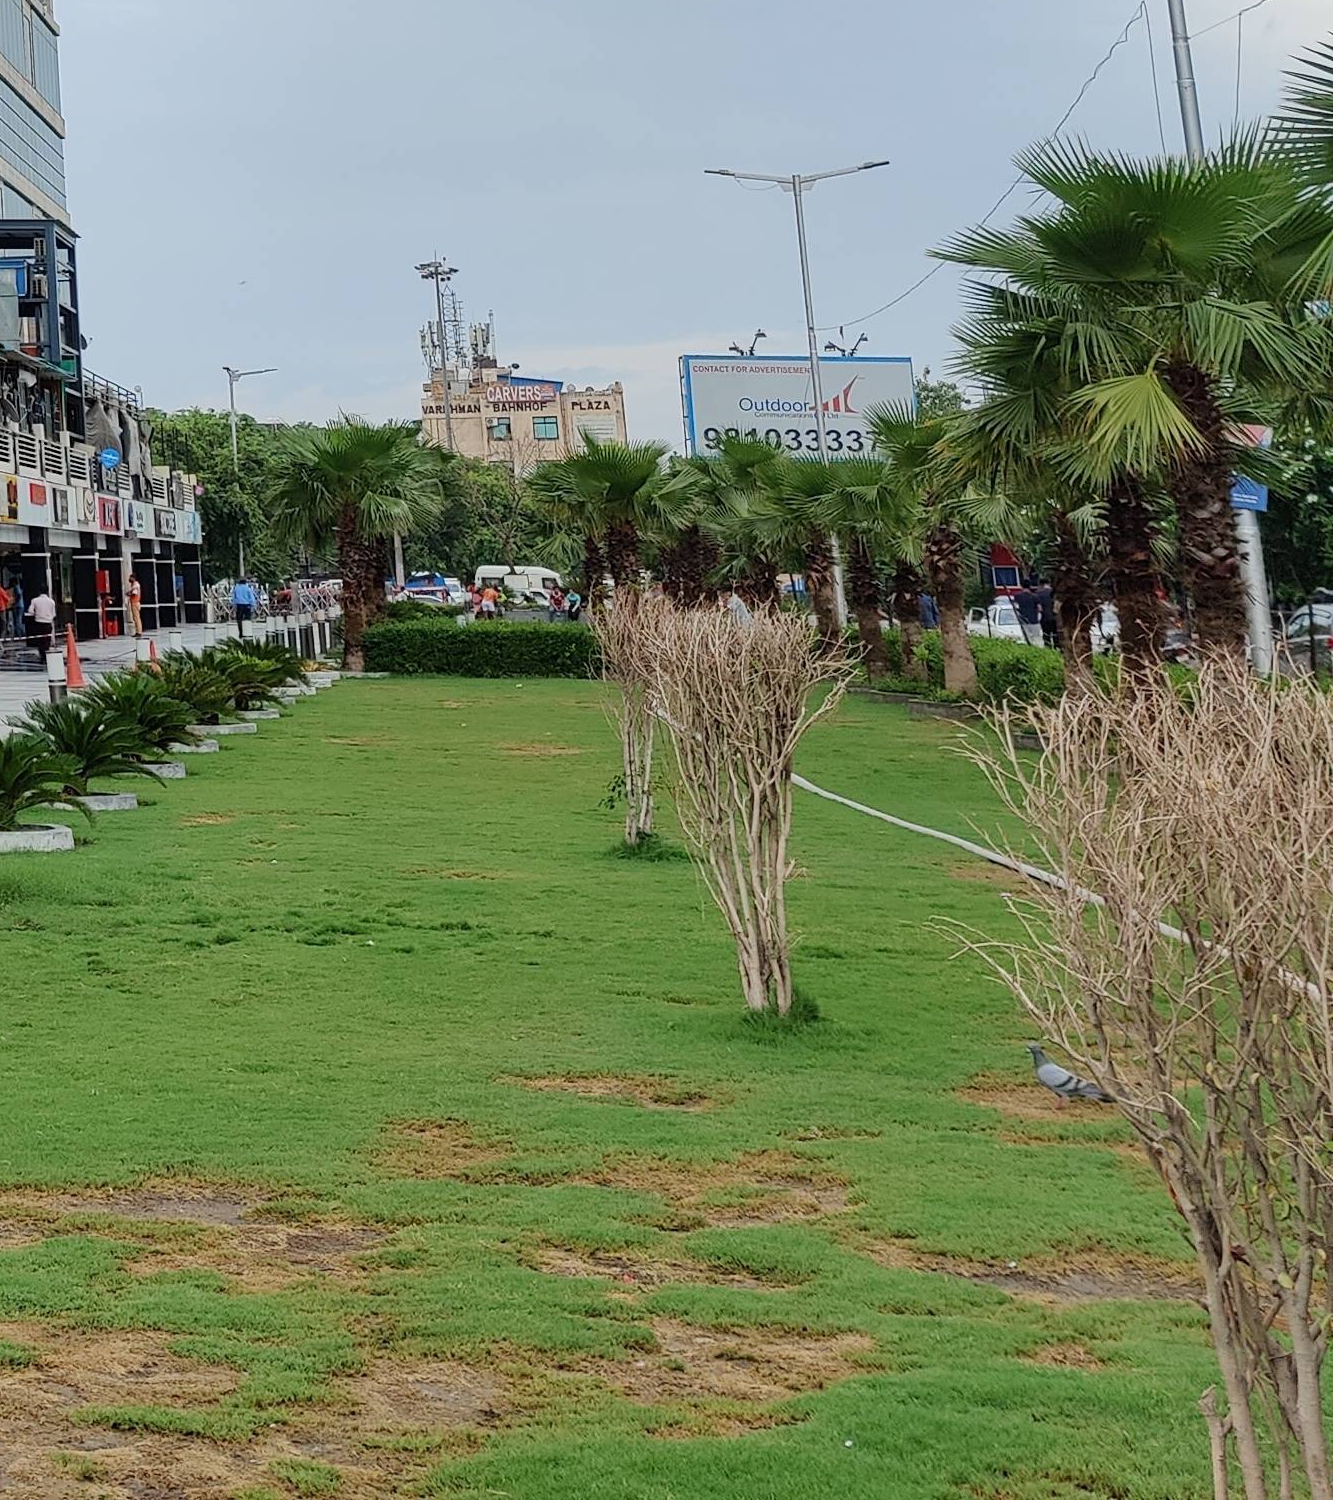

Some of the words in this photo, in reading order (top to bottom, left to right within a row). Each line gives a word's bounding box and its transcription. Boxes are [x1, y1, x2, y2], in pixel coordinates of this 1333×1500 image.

[692, 365, 729, 373] CONTACT
[731, 365, 748, 373] FOR
[486, 385, 542, 401] CARVERS
[421, 404, 481, 415] VARHMAN
[492, 401, 548, 412] BAHNHOF
[571, 400, 612, 411] PLAZA
[739, 397, 810, 412] Outdoor
